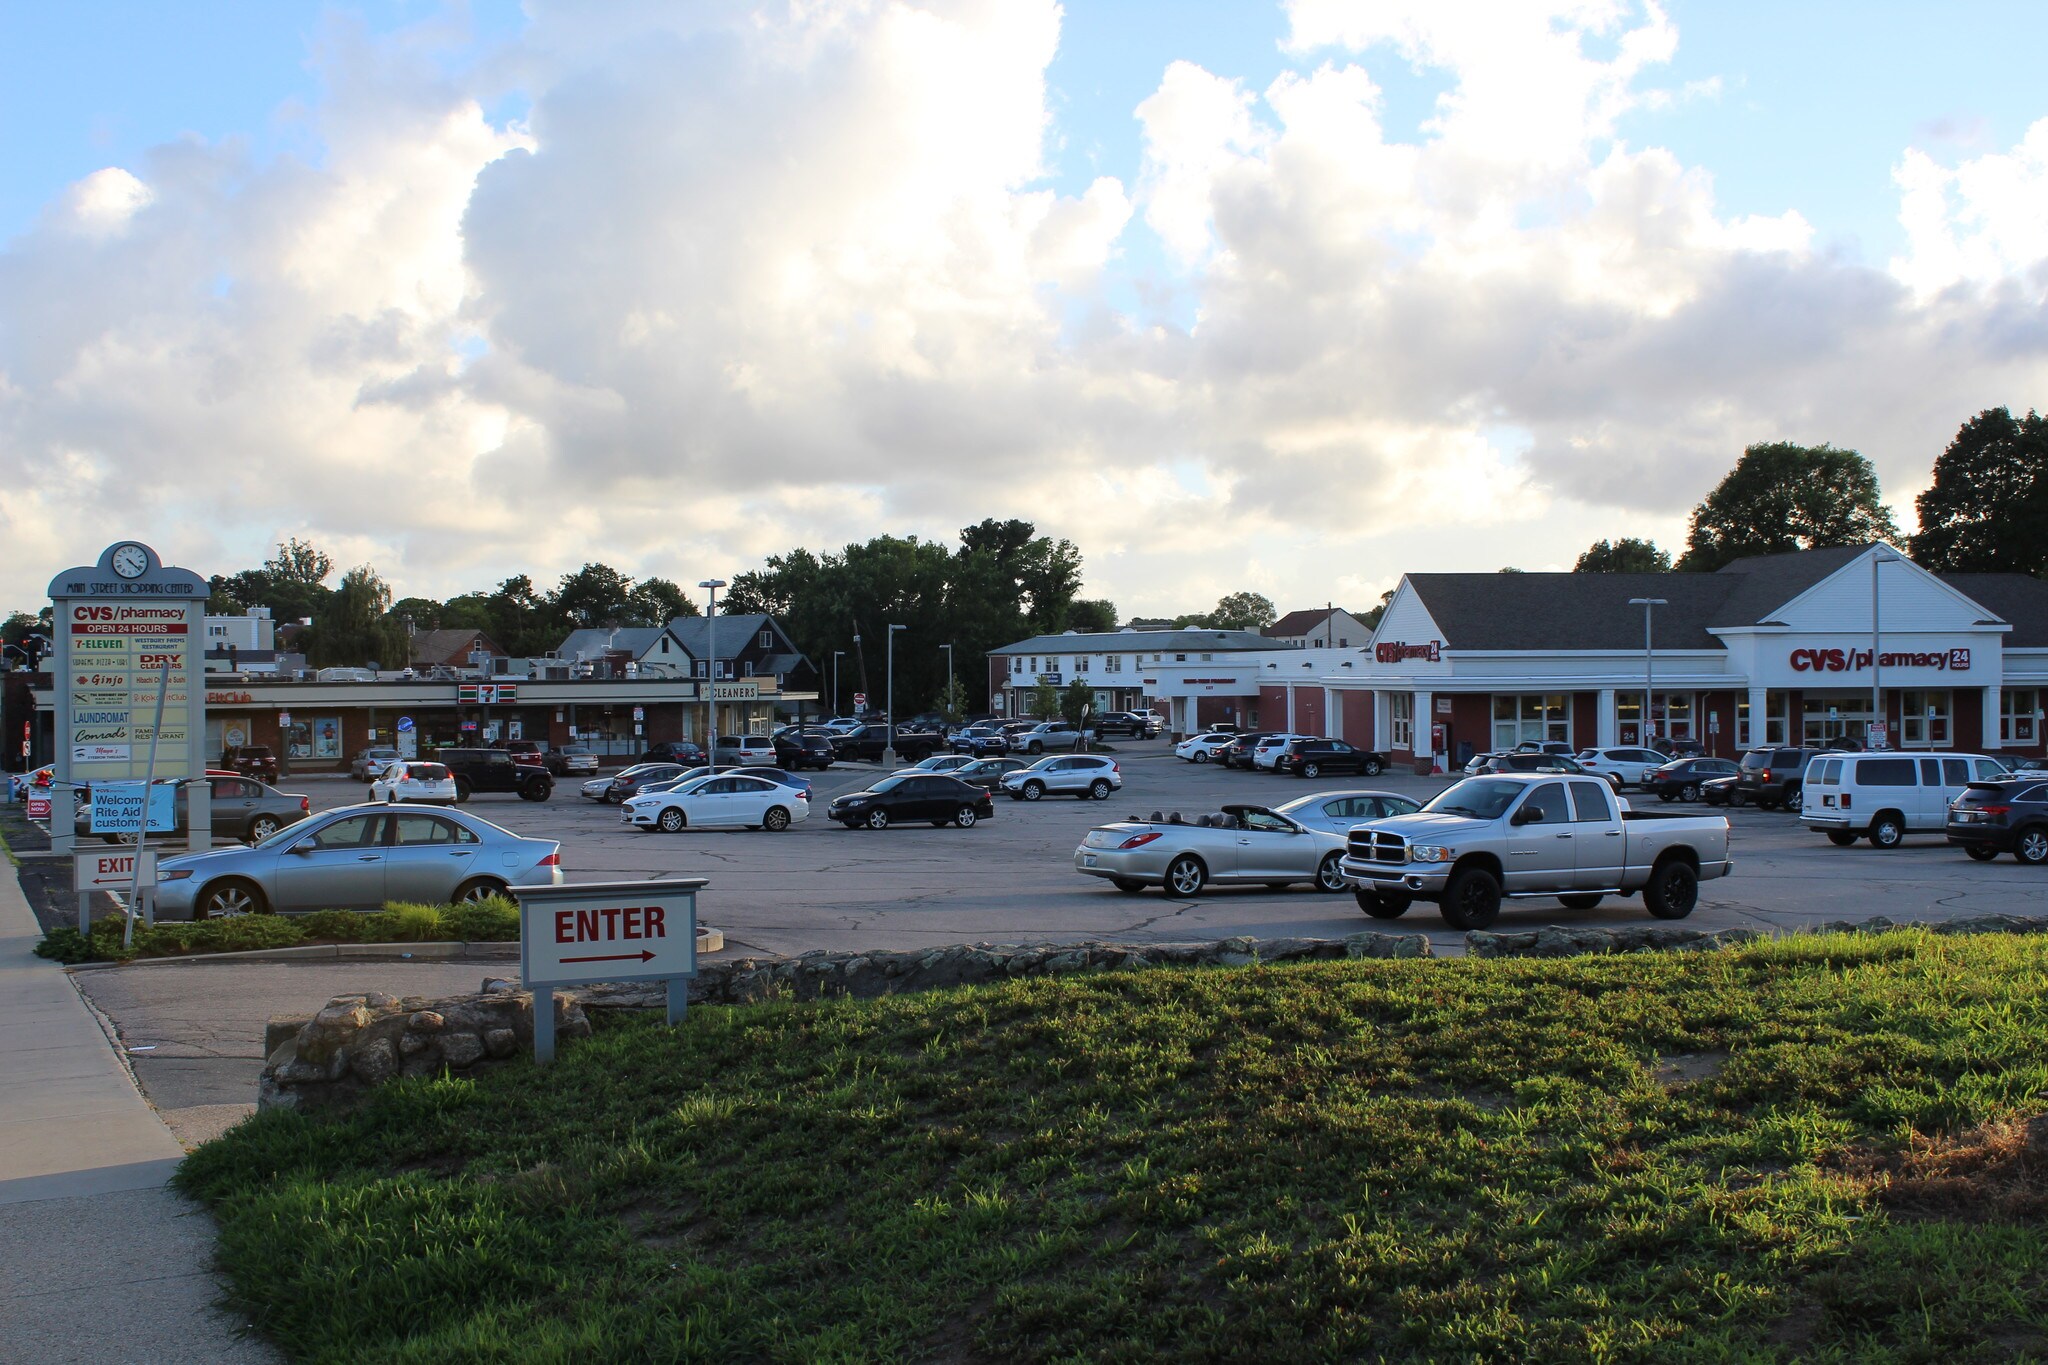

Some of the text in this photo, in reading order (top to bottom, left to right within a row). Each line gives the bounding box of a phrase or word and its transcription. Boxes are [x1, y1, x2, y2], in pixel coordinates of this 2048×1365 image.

[67, 583, 194, 595] MAIN STREET SHOPPING CENTER
[74, 606, 185, 620] CVS/pharmacy
[87, 625, 168, 633] OPEN 24 HOURS
[140, 654, 181, 663] DRY
[1952, 650, 1969, 662] 24
[91, 674, 123, 686] Ginjo
[73, 709, 129, 723] LAUNDROMAT
[75, 727, 127, 742] Conrad's
[1623, 732, 1635, 740] 24
[2018, 726, 2029, 734] 24
[96, 807, 141, 816] Rite Aid
[95, 818, 160, 828] customrs.
[98, 857, 134, 873] EXIT
[555, 906, 666, 944] ENTER
